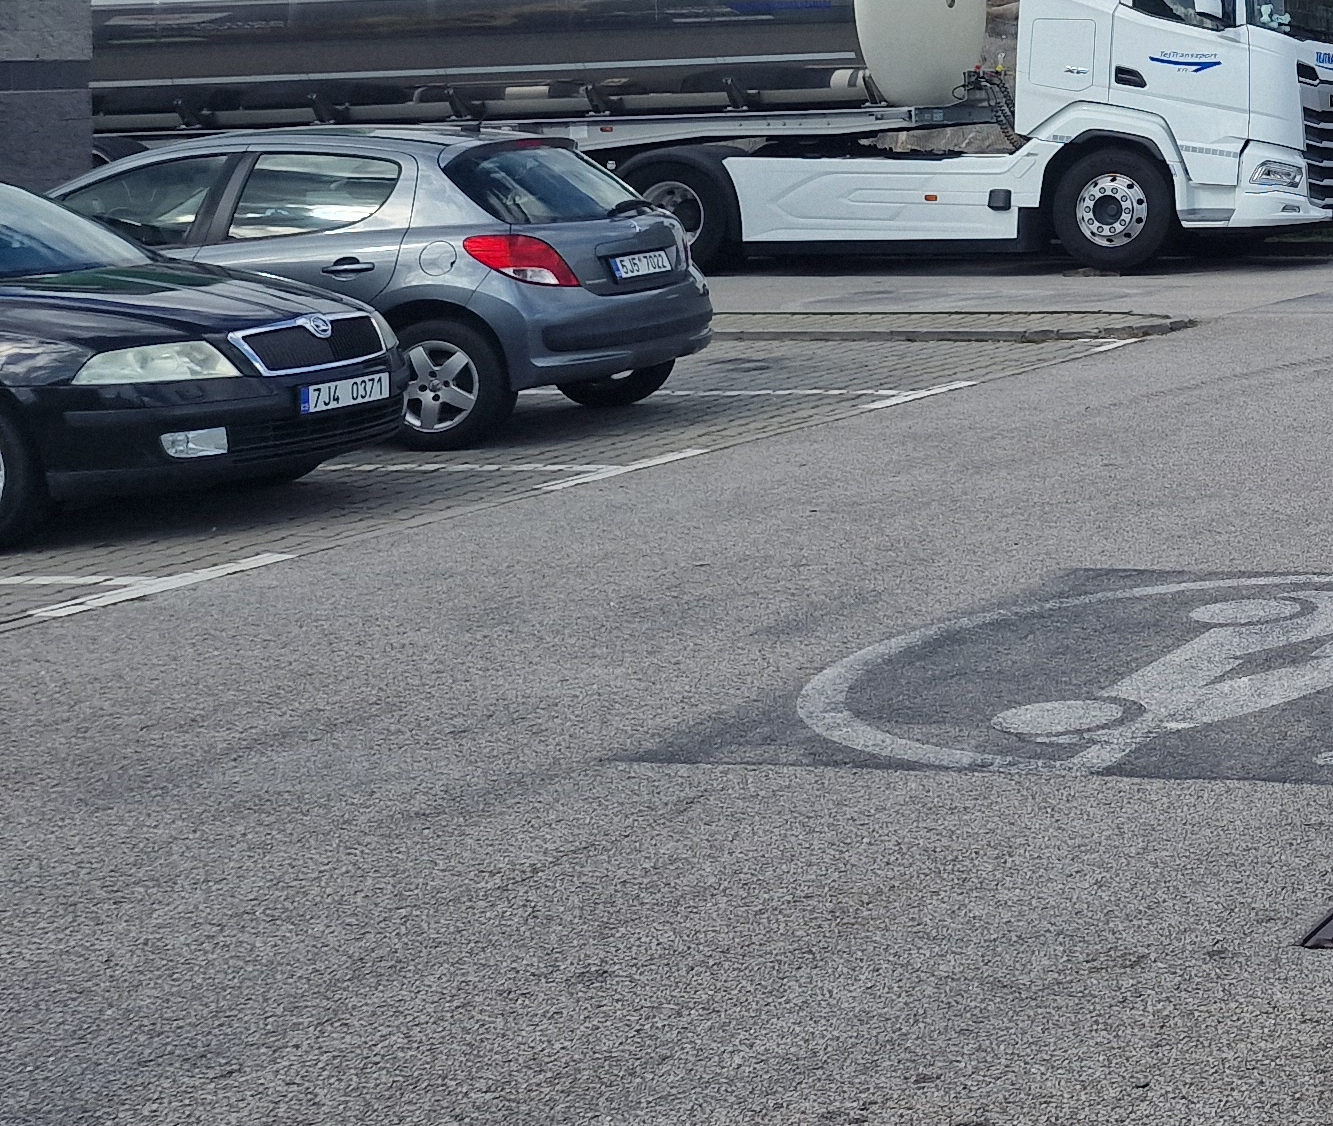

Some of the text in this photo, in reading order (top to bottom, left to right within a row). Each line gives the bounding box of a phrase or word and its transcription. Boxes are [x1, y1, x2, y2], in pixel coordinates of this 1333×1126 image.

[620, 254, 667, 274] 5J5 7022
[313, 376, 383, 409] 7J4 0371
